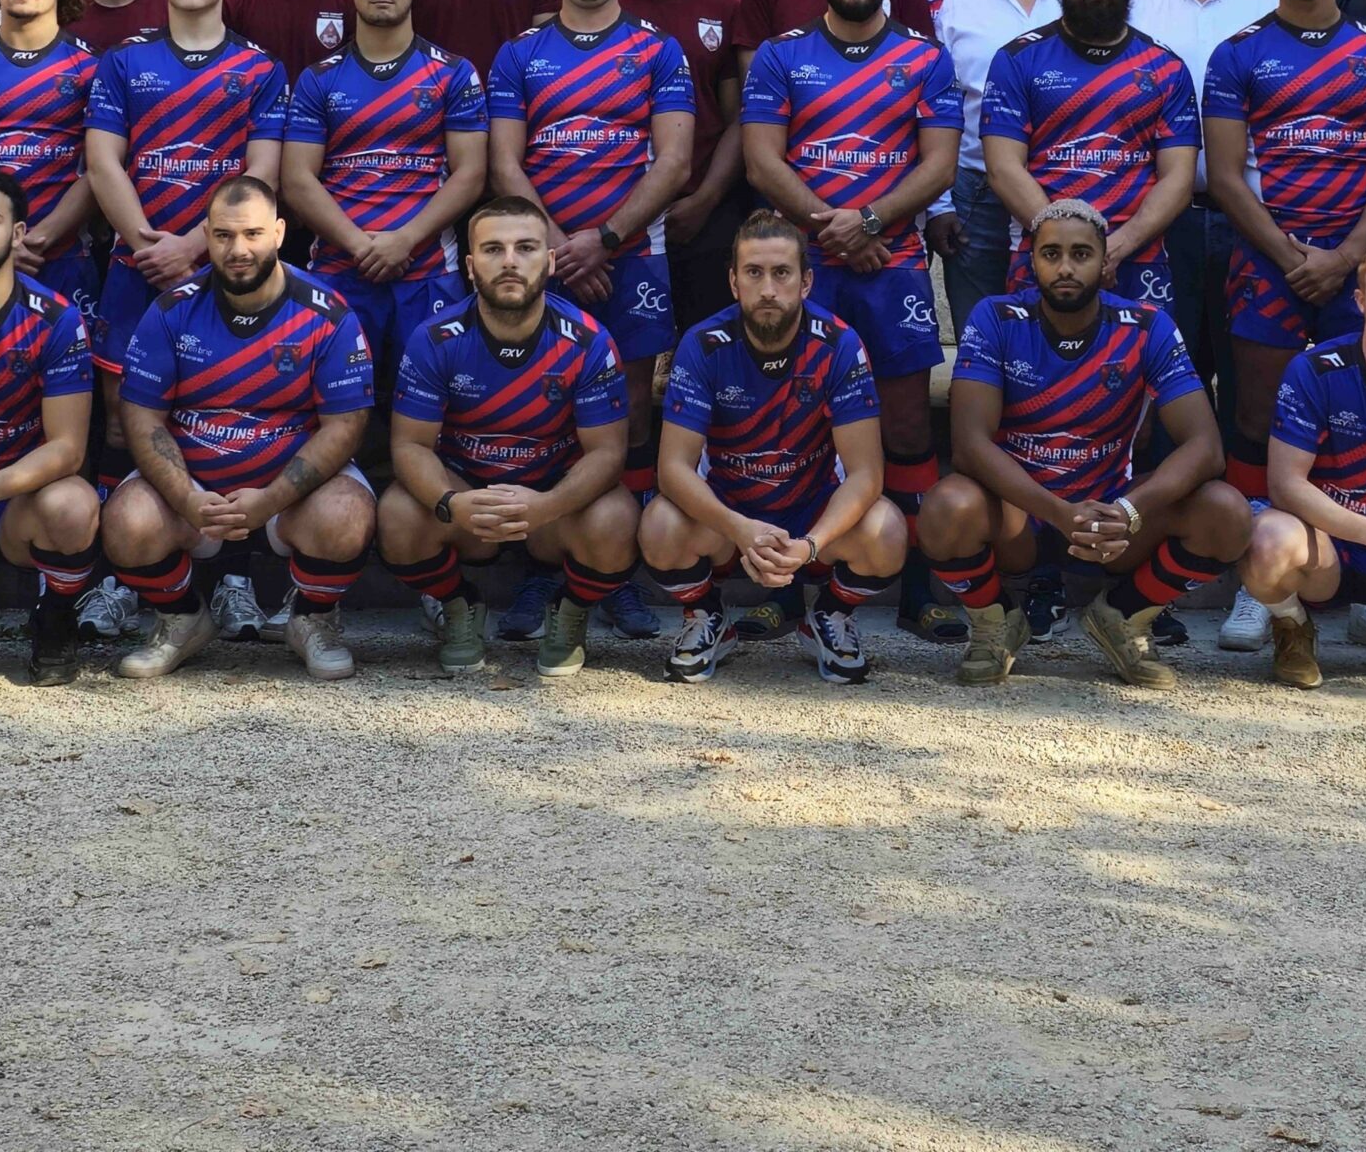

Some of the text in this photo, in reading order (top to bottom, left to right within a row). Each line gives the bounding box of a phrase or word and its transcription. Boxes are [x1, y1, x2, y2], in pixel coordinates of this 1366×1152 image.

[12, 50, 38, 59] FXV
[374, 62, 397, 72] FXV
[791, 70, 810, 81] Sucy
[555, 130, 639, 143] MARTINS & FILS
[1294, 129, 1342, 140] MARTINS
[43, 146, 51, 158] &
[802, 145, 907, 163] MJJ MARTINS & FILS
[1077, 150, 1122, 164] MARTINS
[164, 159, 209, 171] MARTINS
[632, 281, 668, 312] SGC
[901, 294, 937, 325] SGC
[233, 316, 258, 325] FXV
[1059, 341, 1083, 349] FXV
[500, 349, 524, 357] FXV
[763, 358, 787, 369] FXV
[196, 418, 257, 441] MARTINS
[478, 445, 535, 459] MARTINS
[1032, 439, 1121, 463] MARTINS & FILS
[746, 462, 796, 478] MARTINS
